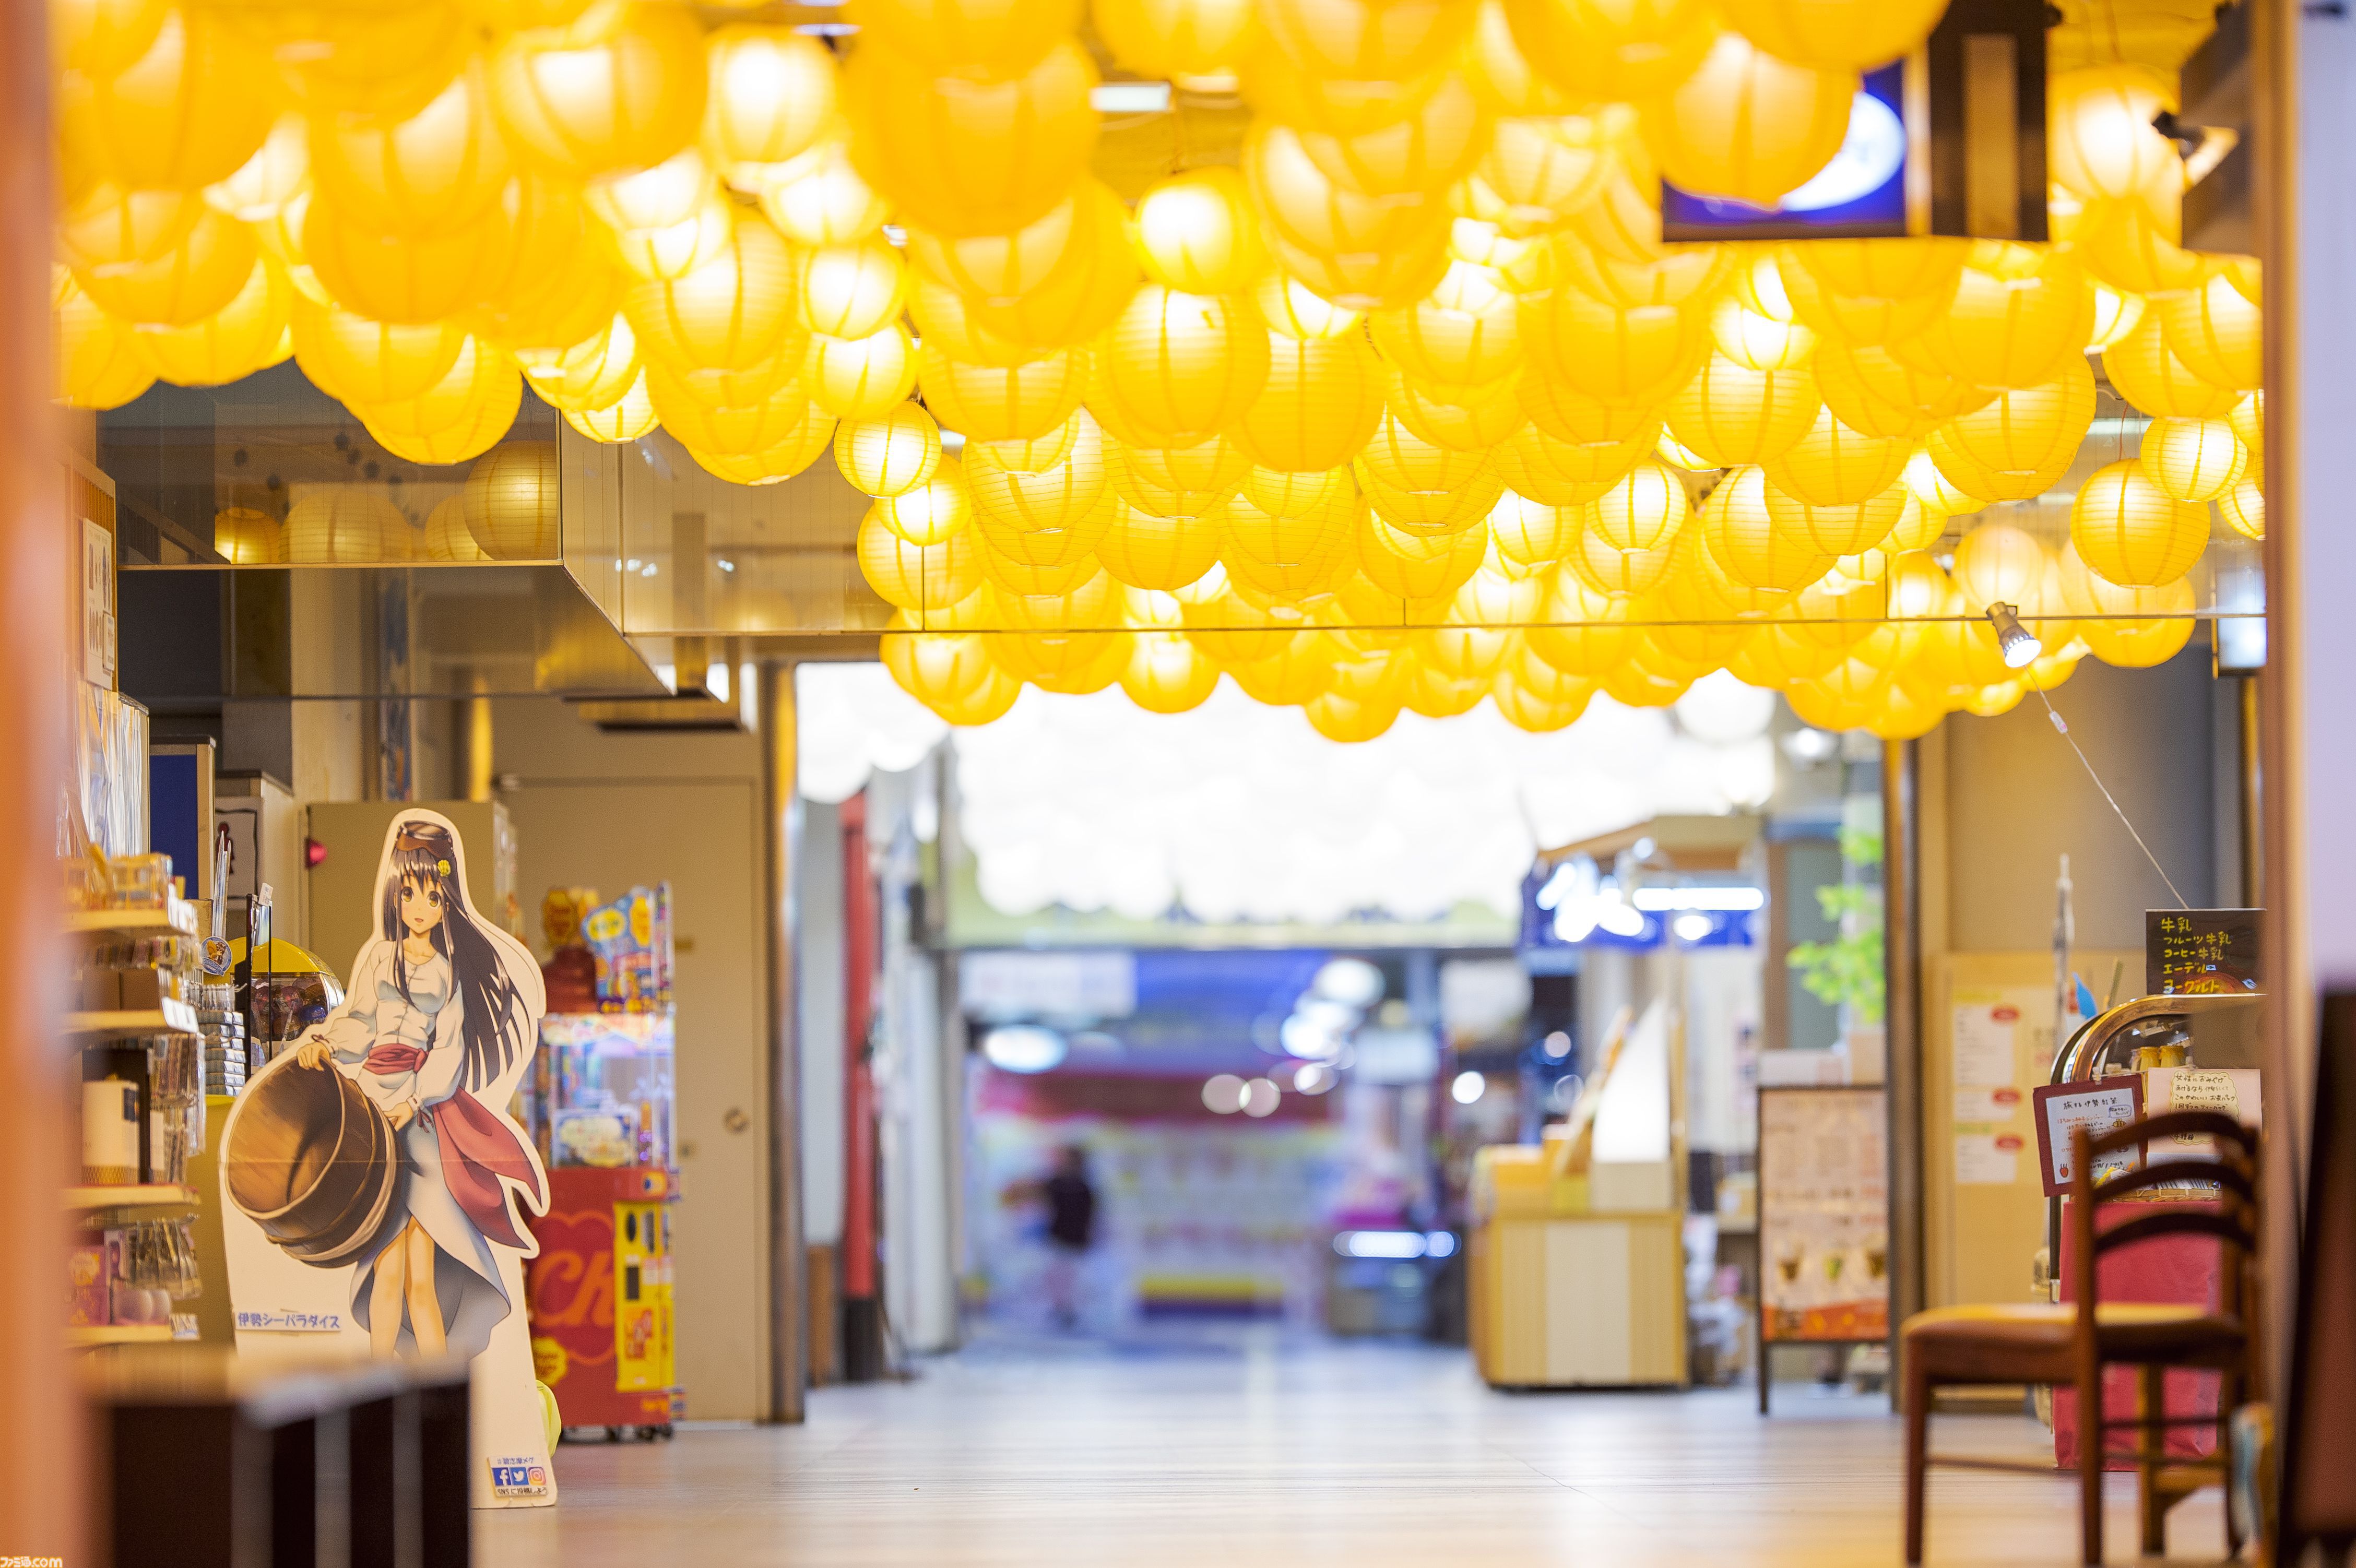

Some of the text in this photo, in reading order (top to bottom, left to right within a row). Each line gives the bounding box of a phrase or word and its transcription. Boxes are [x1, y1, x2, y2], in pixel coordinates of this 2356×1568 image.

[2161, 917, 2192, 933] 牛乳
[2163, 931, 2232, 946] フルーツ牛乳
[2164, 946, 2224, 961] コーヒー牛乳
[238, 1312, 340, 1329] 伊勢シーパラダイス
